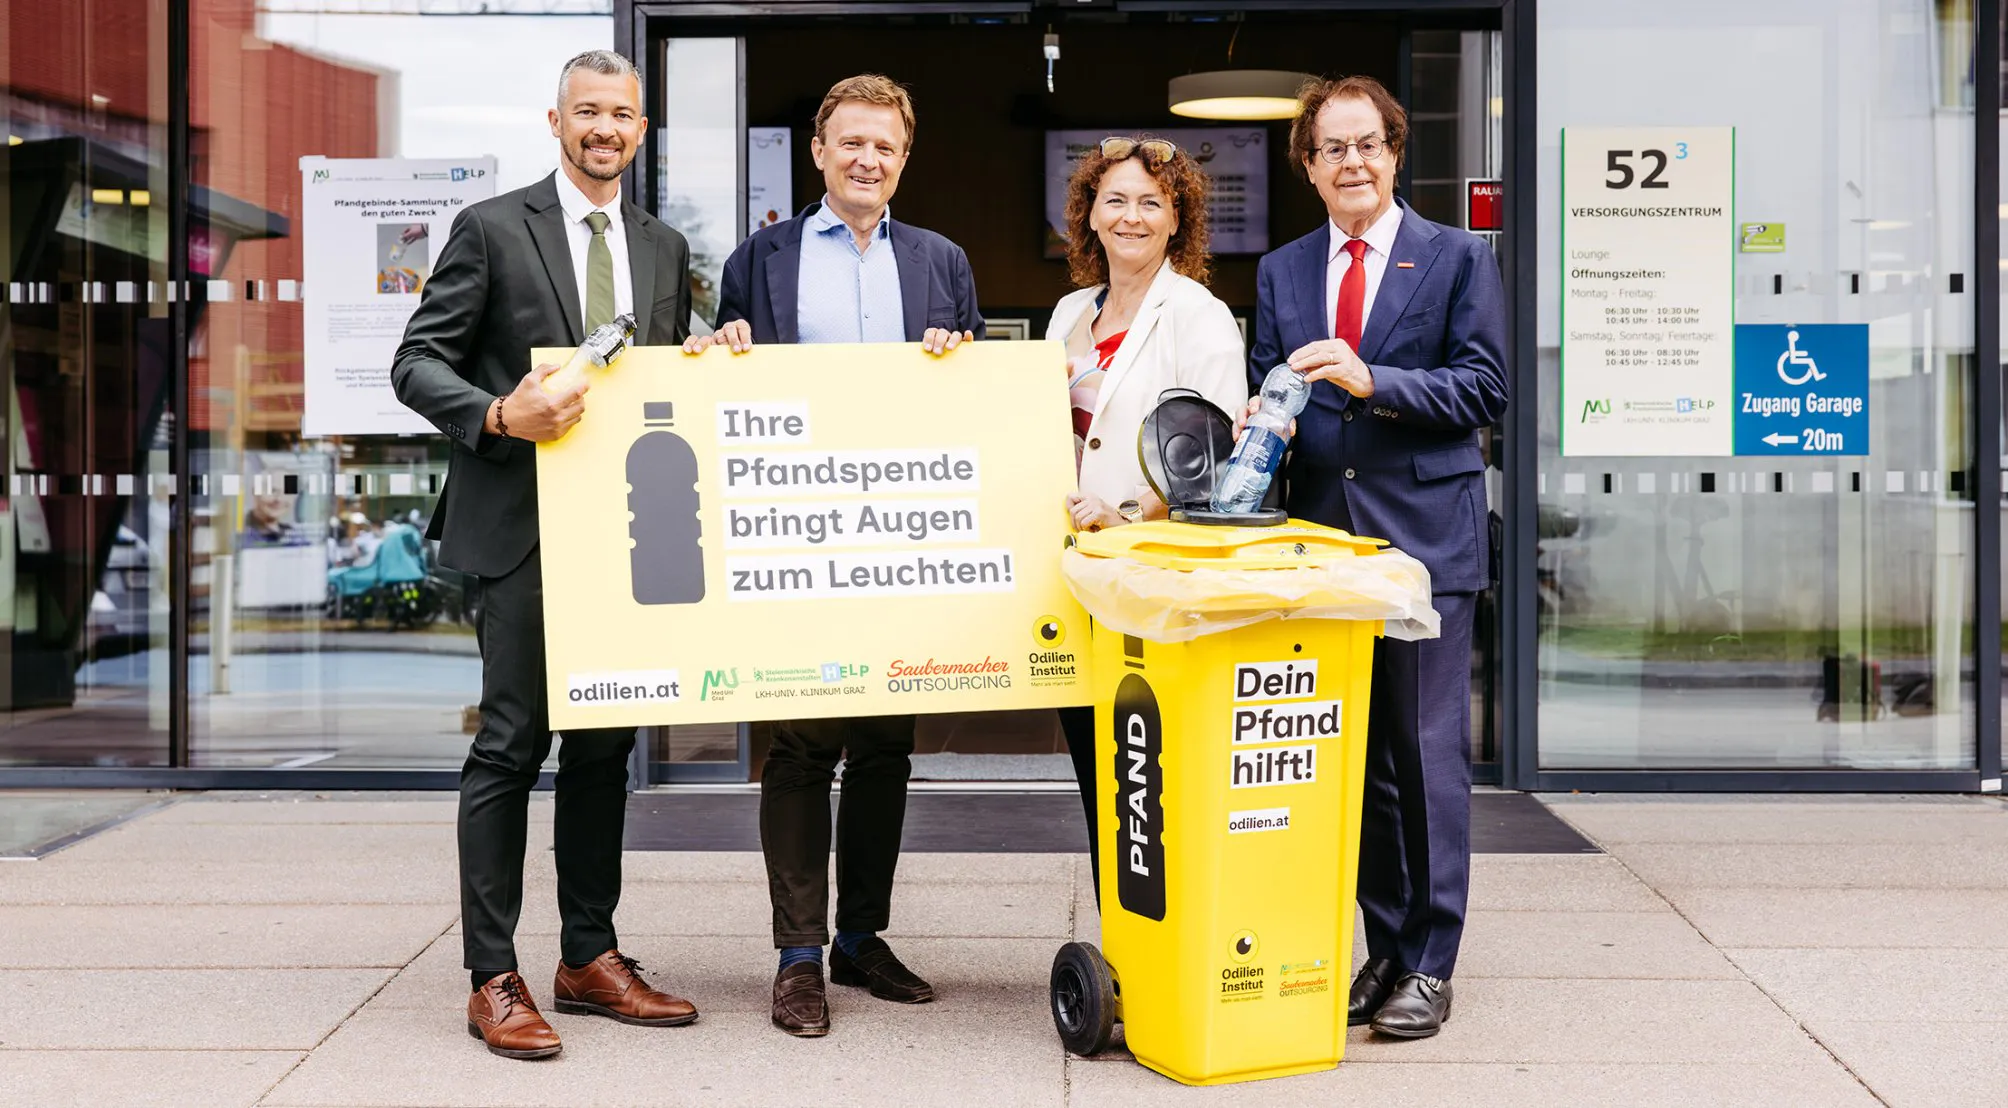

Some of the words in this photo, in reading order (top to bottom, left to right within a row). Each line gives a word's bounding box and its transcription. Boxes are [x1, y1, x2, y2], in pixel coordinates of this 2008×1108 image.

[1606, 149, 1669, 189] 52
[1675, 142, 1688, 160] 3
[334, 199, 448, 208] Pfandgebinde-Sammlung
[380, 210, 405, 218] guten
[408, 209, 437, 217] Zweck
[1572, 207, 1722, 217] VERSORGUNGSZENTRUM
[1571, 267, 1666, 280] Öffnungszeiten:
[1571, 288, 1608, 299] Montag
[1619, 288, 1657, 299] Freitag:
[1570, 331, 1616, 342] Samstag,
[1619, 331, 1664, 342] Sonntag/
[1668, 331, 1718, 342] Feiertage:
[1742, 392, 1800, 417] Zugang
[1806, 392, 1862, 417] Garage
[723, 408, 804, 437] Ihre
[1802, 428, 1843, 451] 20m
[727, 453, 974, 491] Pfandspende
[730, 507, 843, 543] bringt
[856, 505, 973, 540] Augen
[733, 567, 813, 591] zum
[829, 554, 1013, 588] Leuchten!
[887, 656, 1010, 678] Saubermacher
[1029, 652, 1075, 664] Odilien
[821, 662, 869, 683] HELP
[1030, 665, 1076, 676] Institut
[569, 680, 680, 702] odilien.at
[888, 674, 1011, 693] OUTSOURCING
[1237, 664, 1315, 698] Dein
[755, 689, 798, 699] LKH-UNIV.
[801, 687, 841, 697] KLINIKUM
[843, 685, 866, 695] GRAZ
[1235, 704, 1339, 742] Pfand
[1233, 749, 1313, 785] hilft!
[1127, 713, 1149, 877] PFAND
[1229, 815, 1289, 831] odilien.at
[1222, 966, 1264, 980] Odilien
[1221, 979, 1263, 992] Institut
[1280, 985, 1328, 997] OUTSOURCING
